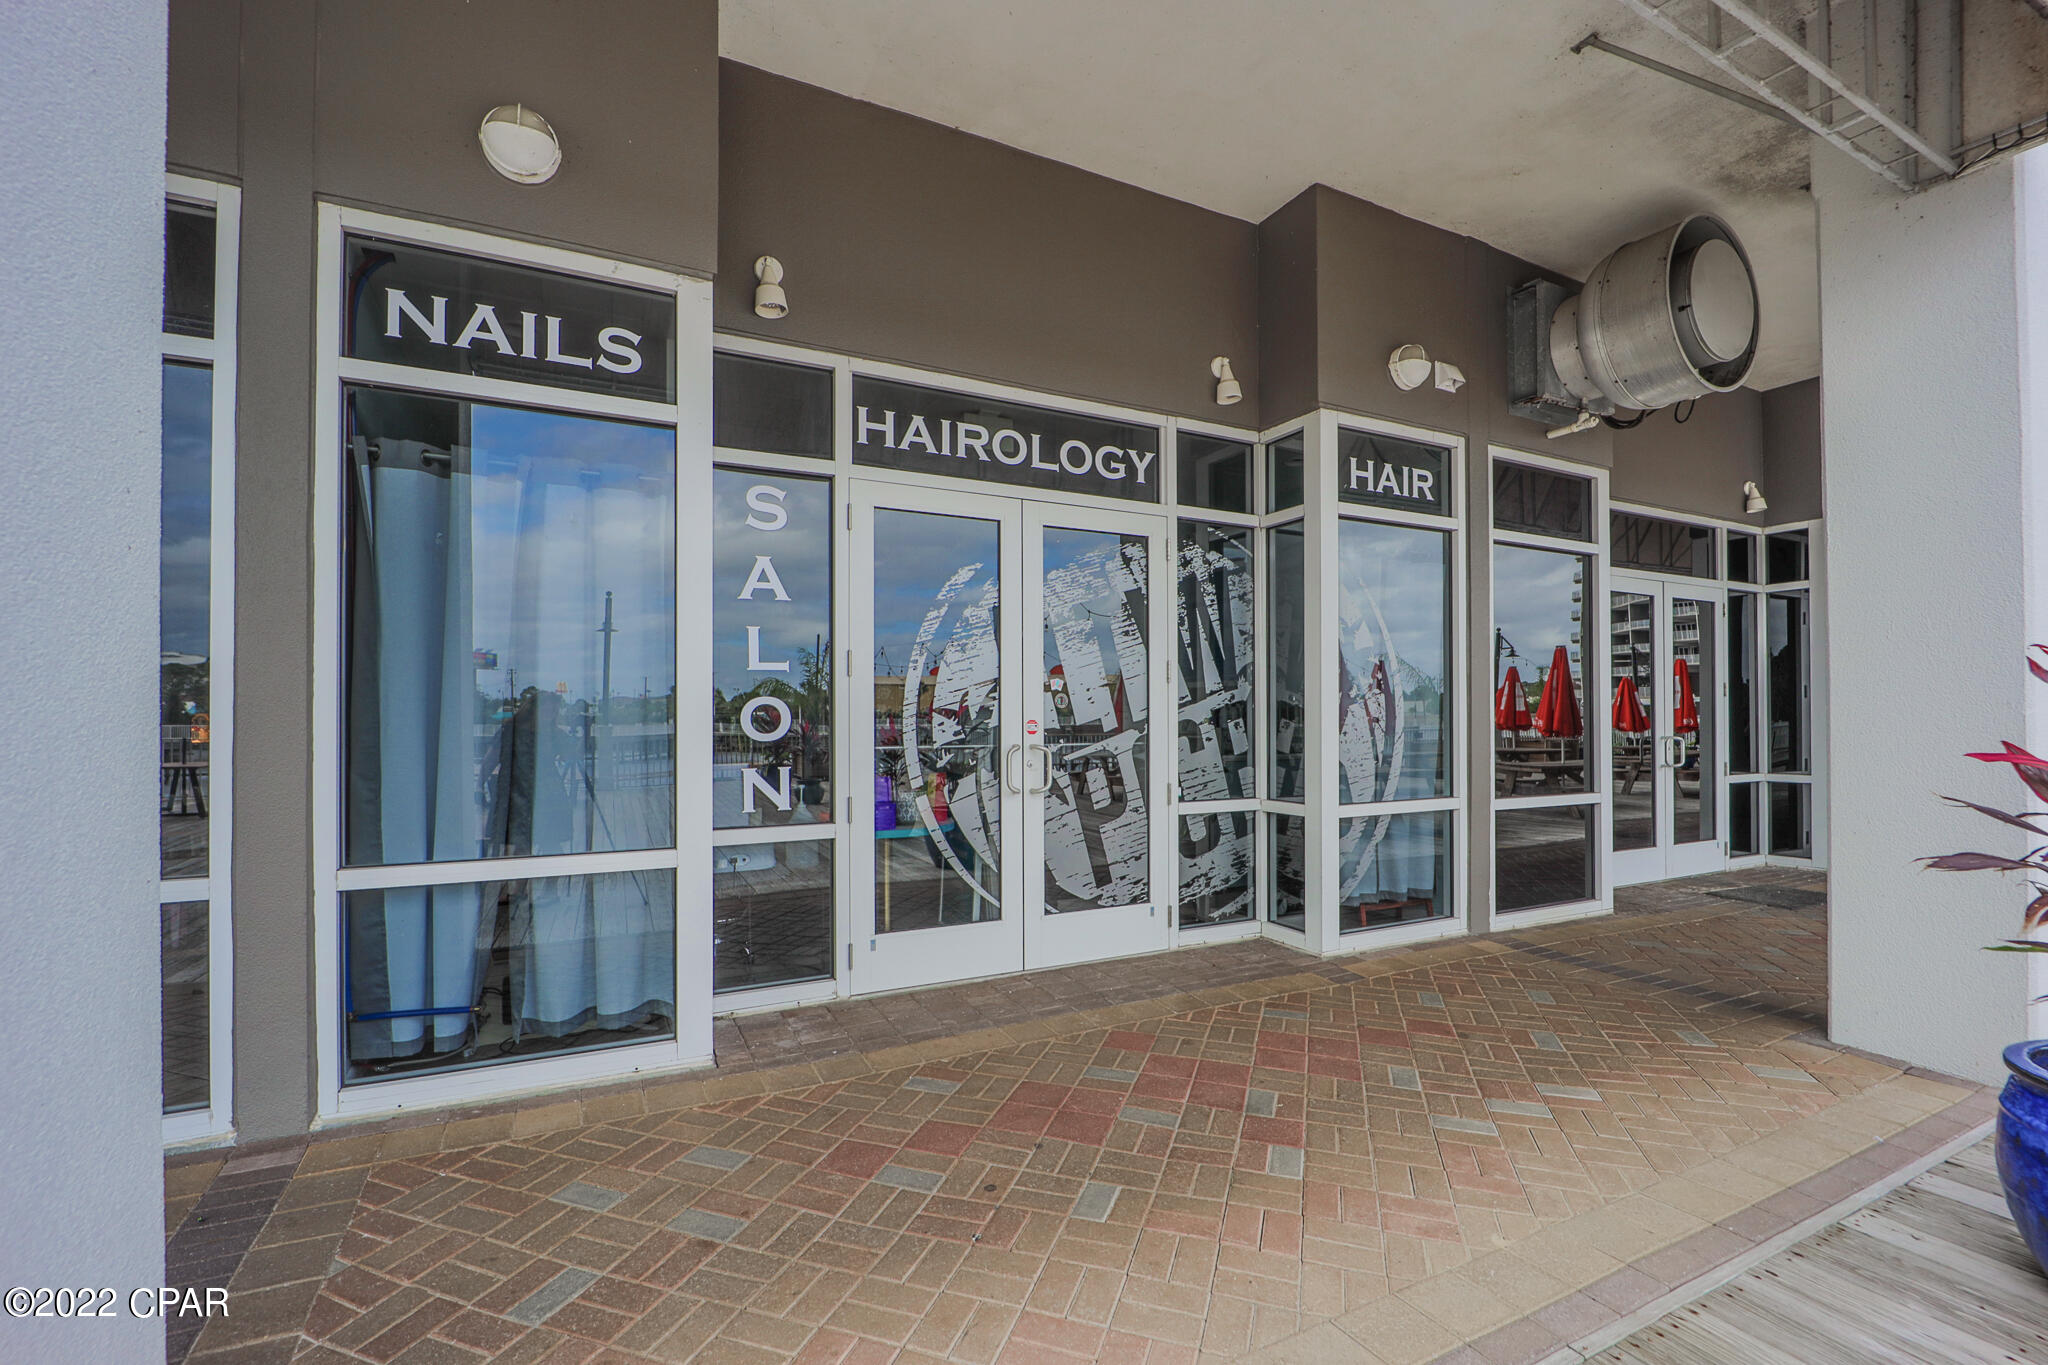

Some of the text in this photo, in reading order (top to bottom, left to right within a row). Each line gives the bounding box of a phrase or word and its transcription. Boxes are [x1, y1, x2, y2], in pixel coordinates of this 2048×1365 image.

[384, 287, 643, 374] NAILS
[856, 405, 1156, 484] HAIROLOGY
[1349, 456, 1435, 501] HAIR
[737, 484, 793, 814] SALON
